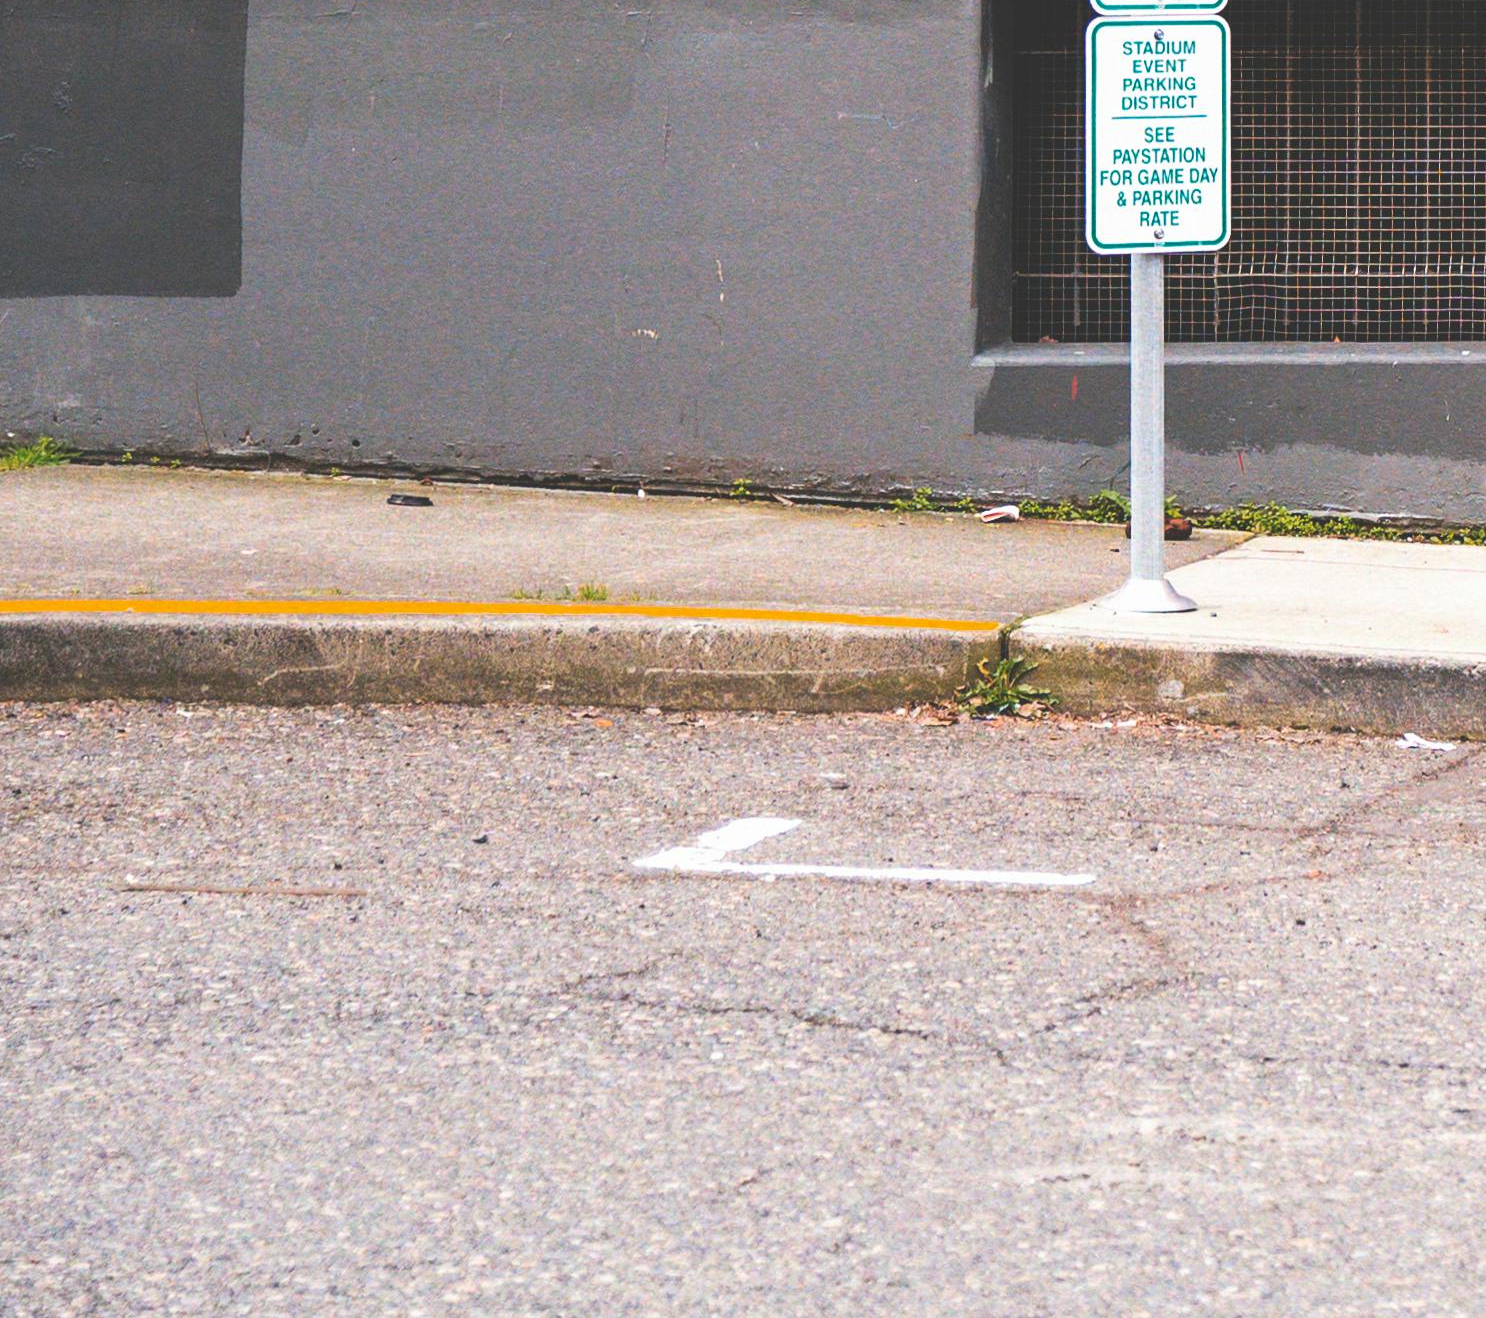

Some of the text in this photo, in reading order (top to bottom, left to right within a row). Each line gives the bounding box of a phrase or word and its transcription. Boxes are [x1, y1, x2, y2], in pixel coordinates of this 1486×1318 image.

[1122, 40, 1196, 55] STADIUM
[1132, 59, 1187, 74] EVENT
[1122, 76, 1196, 92] PARKING
[1121, 95, 1197, 111] DISTRICT
[1144, 127, 1175, 143] SEE
[1113, 147, 1206, 165] PAYSTATION
[1100, 167, 1218, 186] FOR GAME DAY
[1116, 188, 1202, 207] & PARKING
[1139, 210, 1180, 227] RATE
